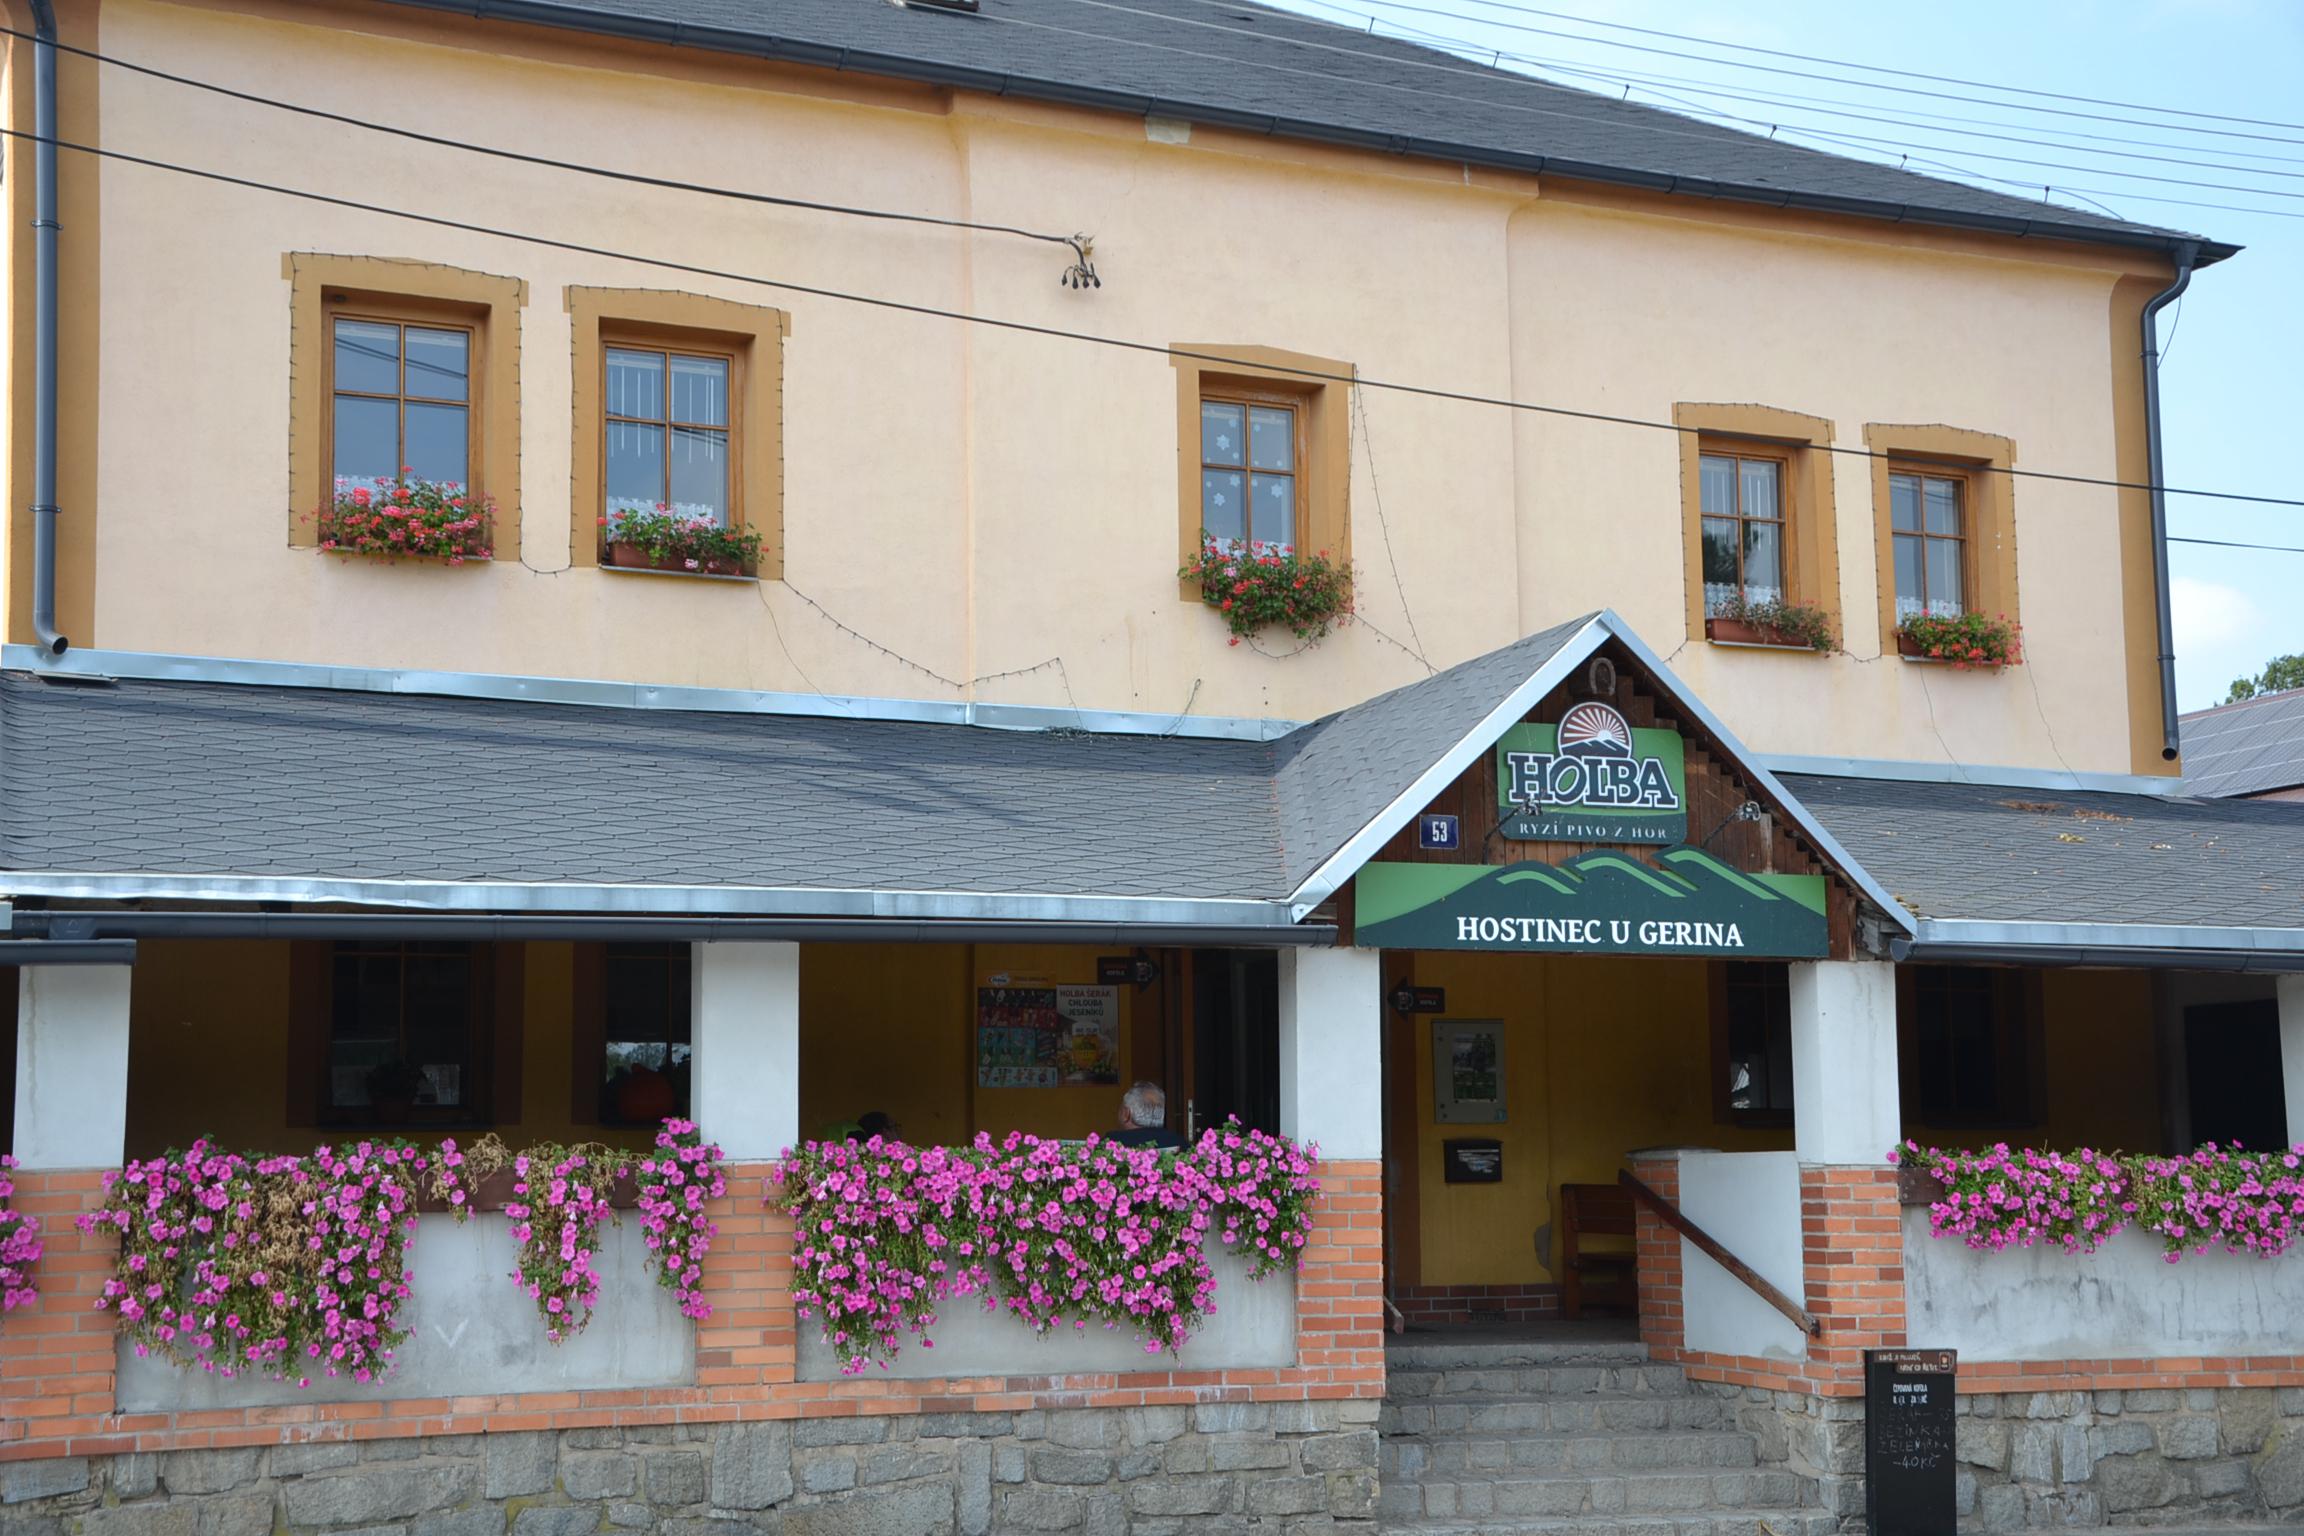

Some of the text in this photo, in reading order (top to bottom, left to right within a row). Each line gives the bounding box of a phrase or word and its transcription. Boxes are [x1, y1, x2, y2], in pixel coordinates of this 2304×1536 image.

[1507, 752, 1679, 808] HOLBA
[1432, 821, 1448, 842] 53
[1519, 820, 1667, 839] RYZÍ PIVO Z HOR
[1456, 916, 1745, 947] HOSTINEC U GERINA
